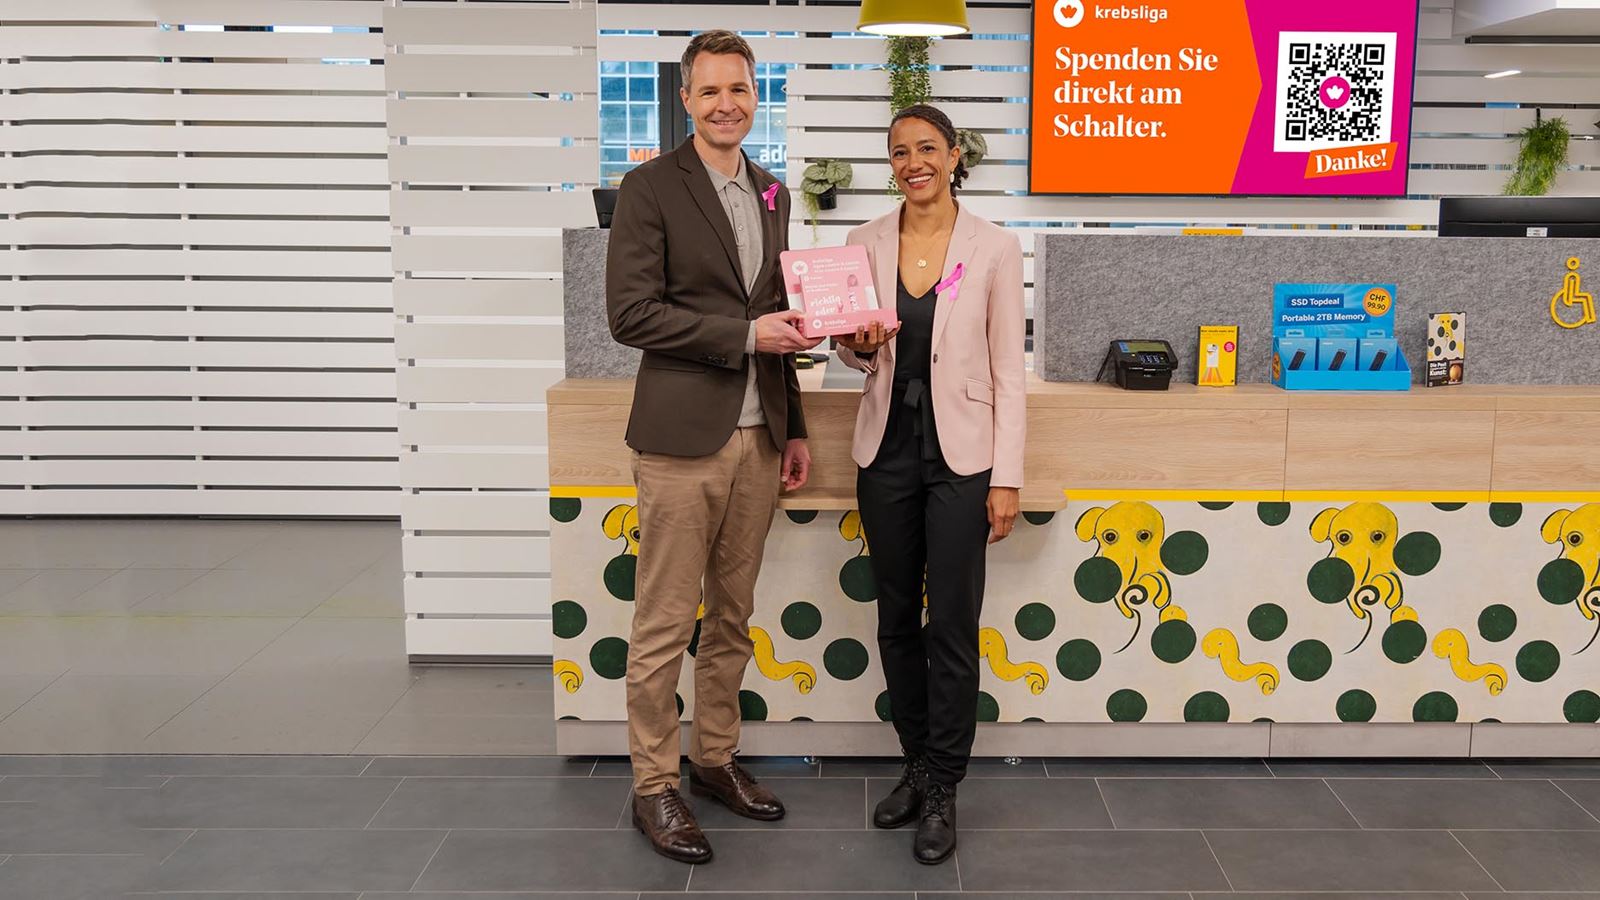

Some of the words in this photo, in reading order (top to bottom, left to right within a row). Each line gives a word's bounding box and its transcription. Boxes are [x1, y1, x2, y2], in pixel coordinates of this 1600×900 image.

[1095, 4, 1168, 23] krebsliga
[1055, 46, 1172, 76] Spenden
[1178, 47, 1219, 71] Sie
[1053, 80, 1135, 105] direkt
[1140, 86, 1182, 105] am
[1053, 113, 1167, 138] Schalter.
[1315, 148, 1387, 174] Danke!
[1291, 298, 1308, 306] SSD
[1309, 297, 1340, 307] Topdeal
[1367, 302, 1386, 310] 99.90
[1369, 293, 1386, 302] CHF
[1282, 314, 1315, 322] Portable
[1316, 313, 1332, 321] 2TB
[1333, 312, 1366, 322] Memory
